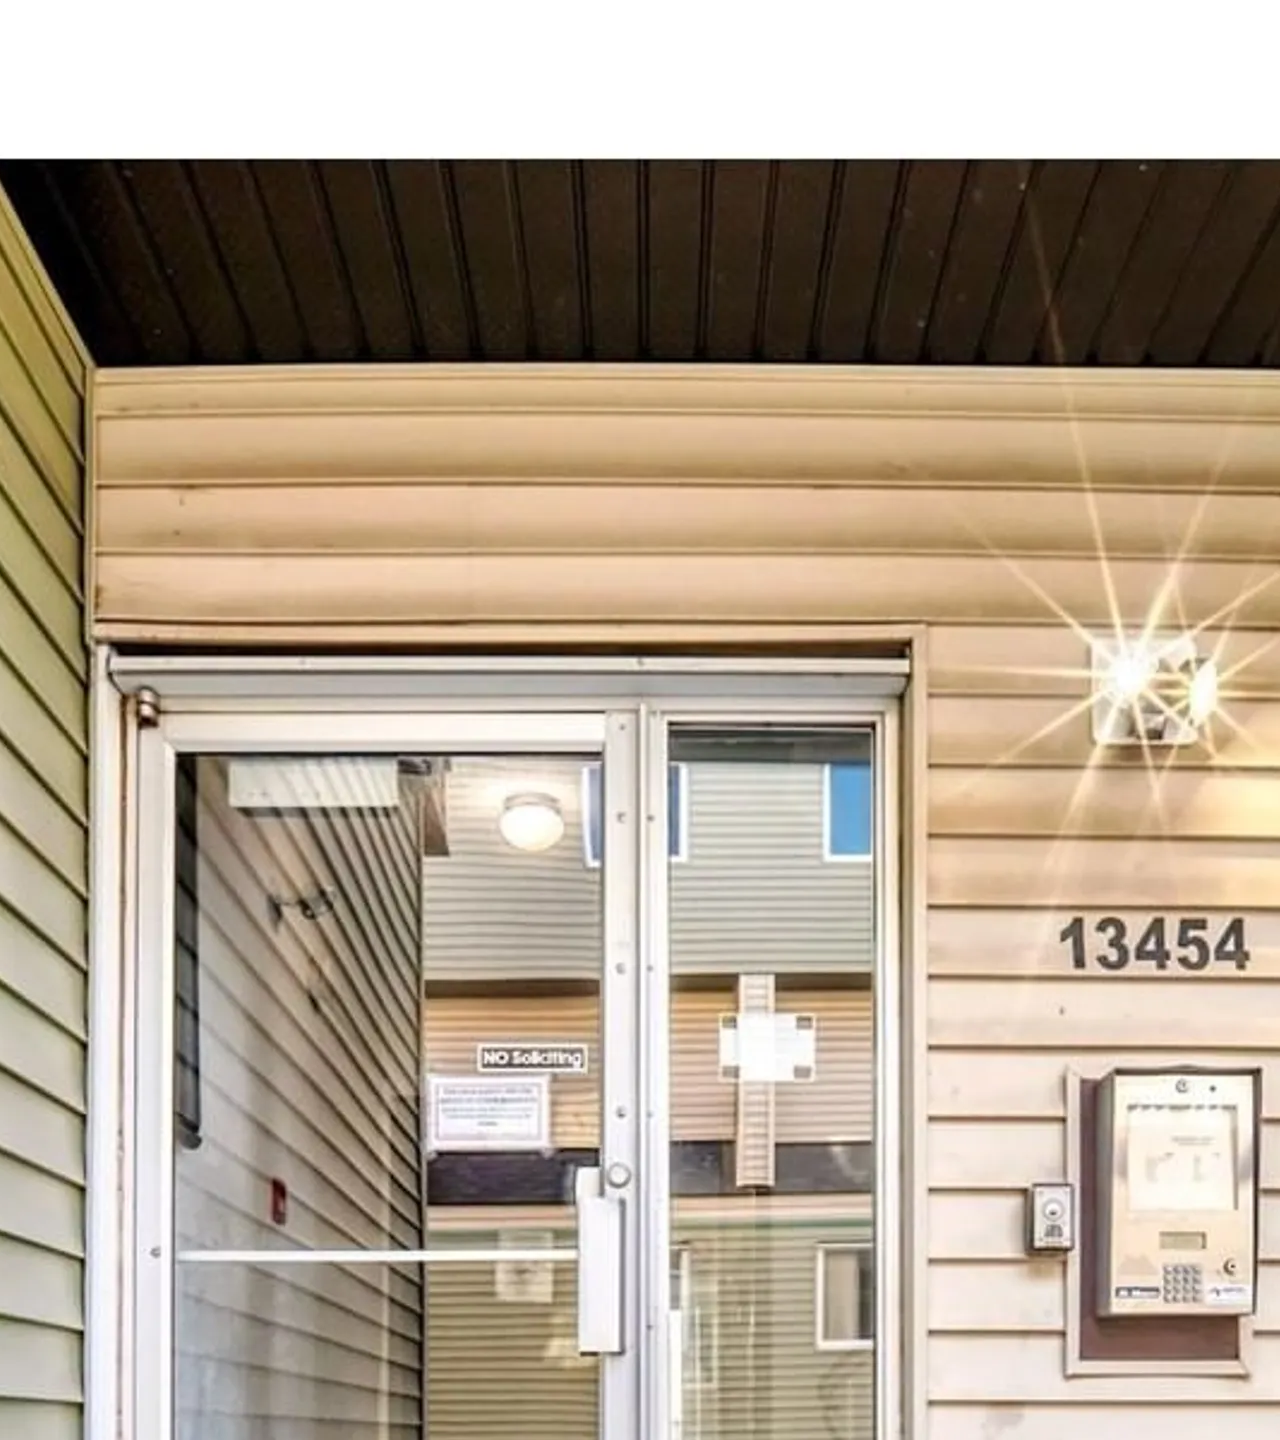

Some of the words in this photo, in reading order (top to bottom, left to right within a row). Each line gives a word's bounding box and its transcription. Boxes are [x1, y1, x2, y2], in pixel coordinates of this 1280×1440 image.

[1059, 916, 1251, 971] 13454
[483, 1049, 509, 1066] NO
[512, 1048, 582, 1069] Soliciting
